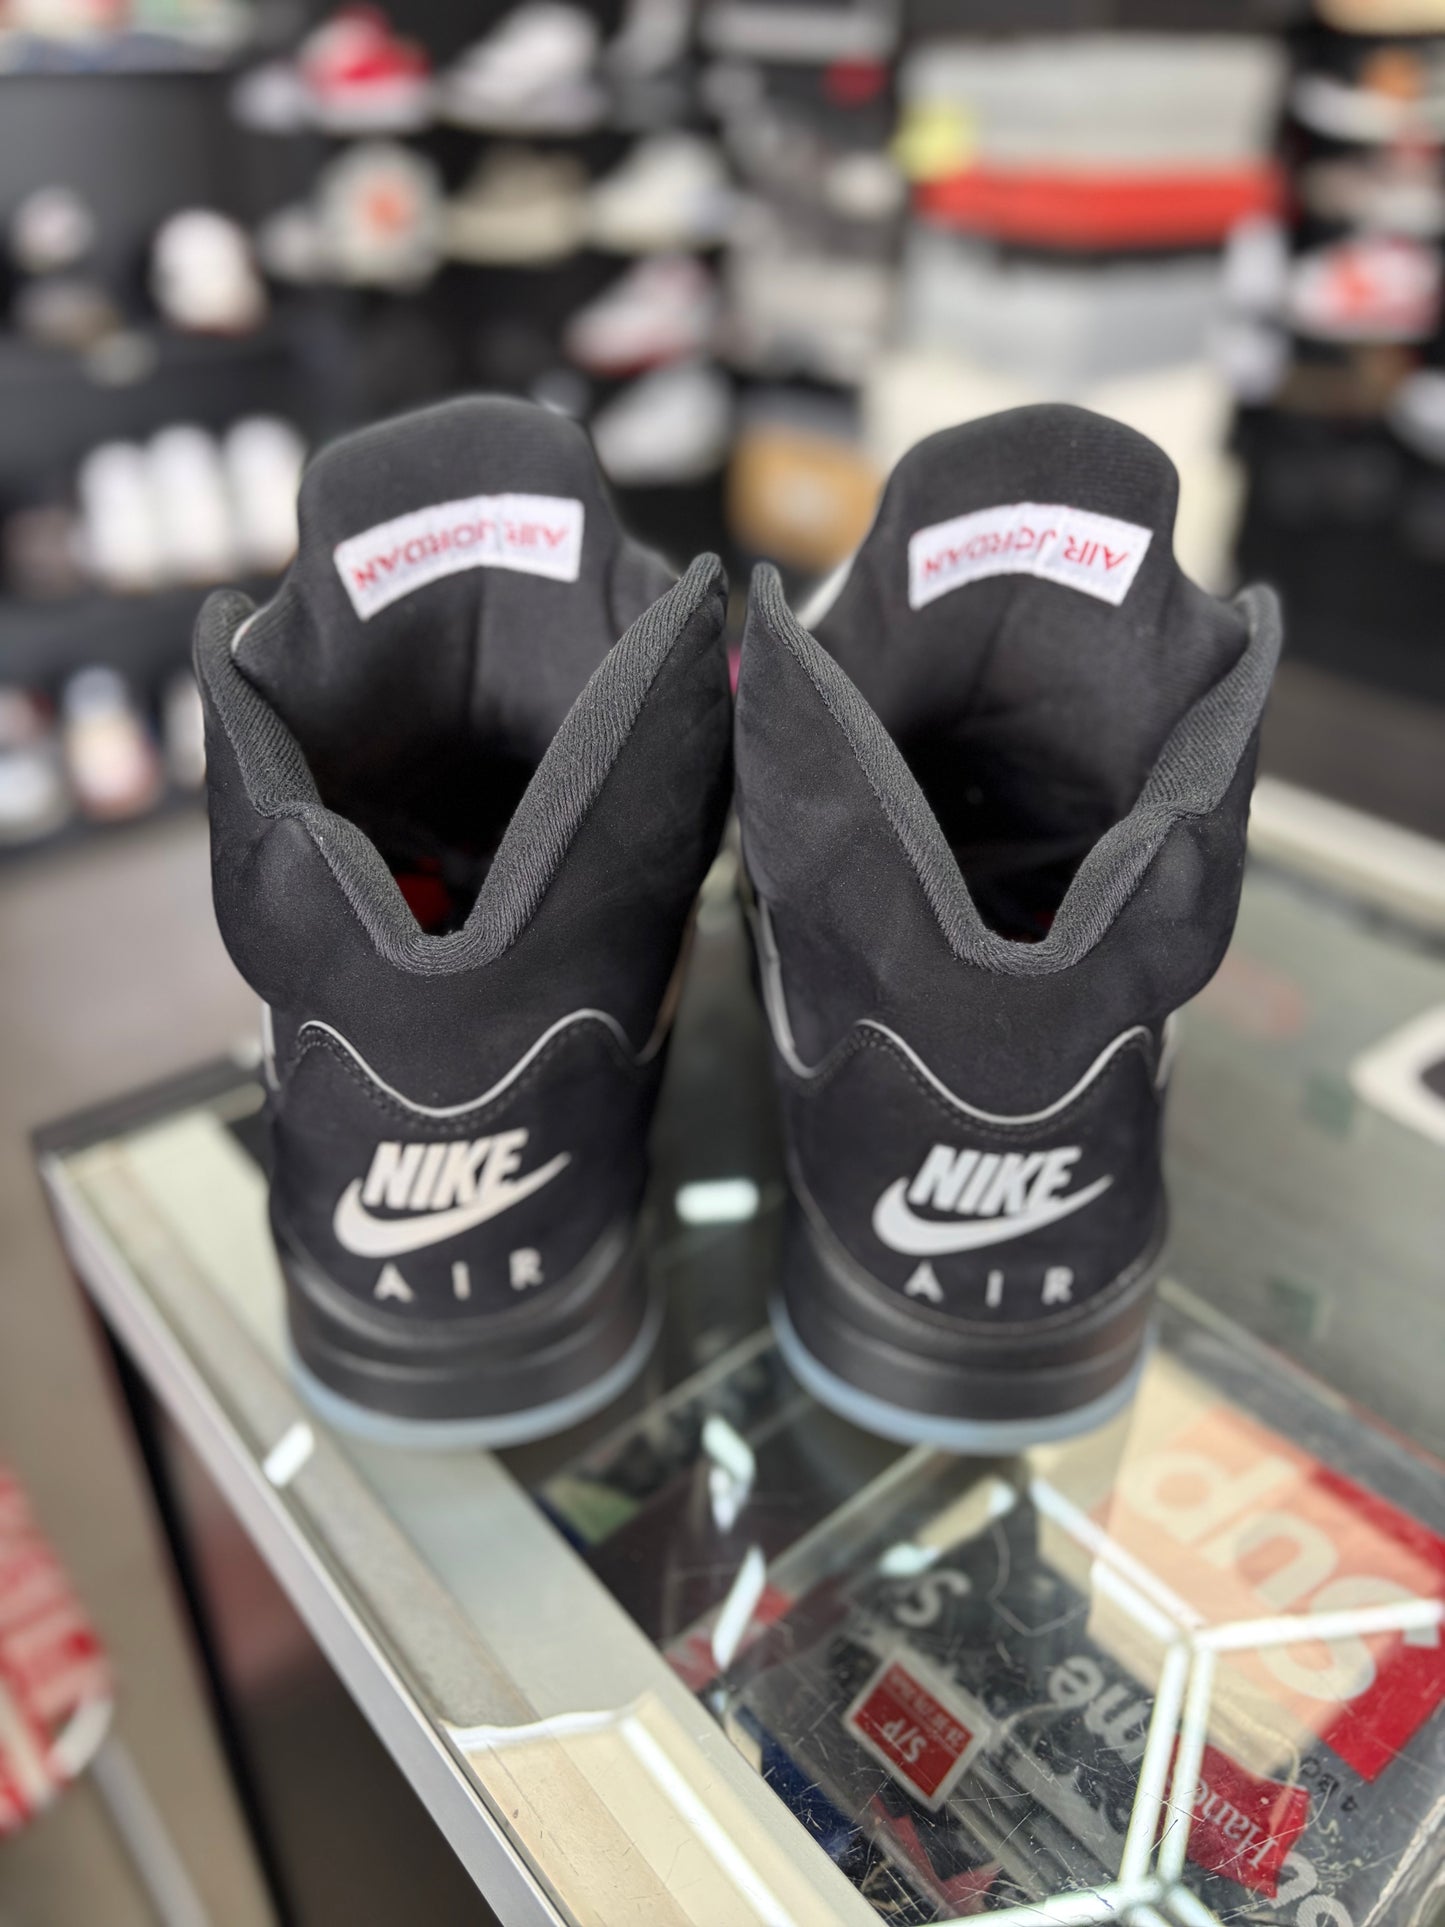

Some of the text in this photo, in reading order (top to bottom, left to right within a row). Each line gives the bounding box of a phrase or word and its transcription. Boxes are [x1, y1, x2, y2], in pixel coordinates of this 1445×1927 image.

[350, 518, 570, 590] AIR JORDAN
[922, 526, 1128, 580] AIR JORDAN
[362, 1127, 529, 1210] NIKE
[907, 1143, 1082, 1216] NIKE
[374, 1247, 545, 1302] AIR
[904, 1260, 1074, 1308] AIR
